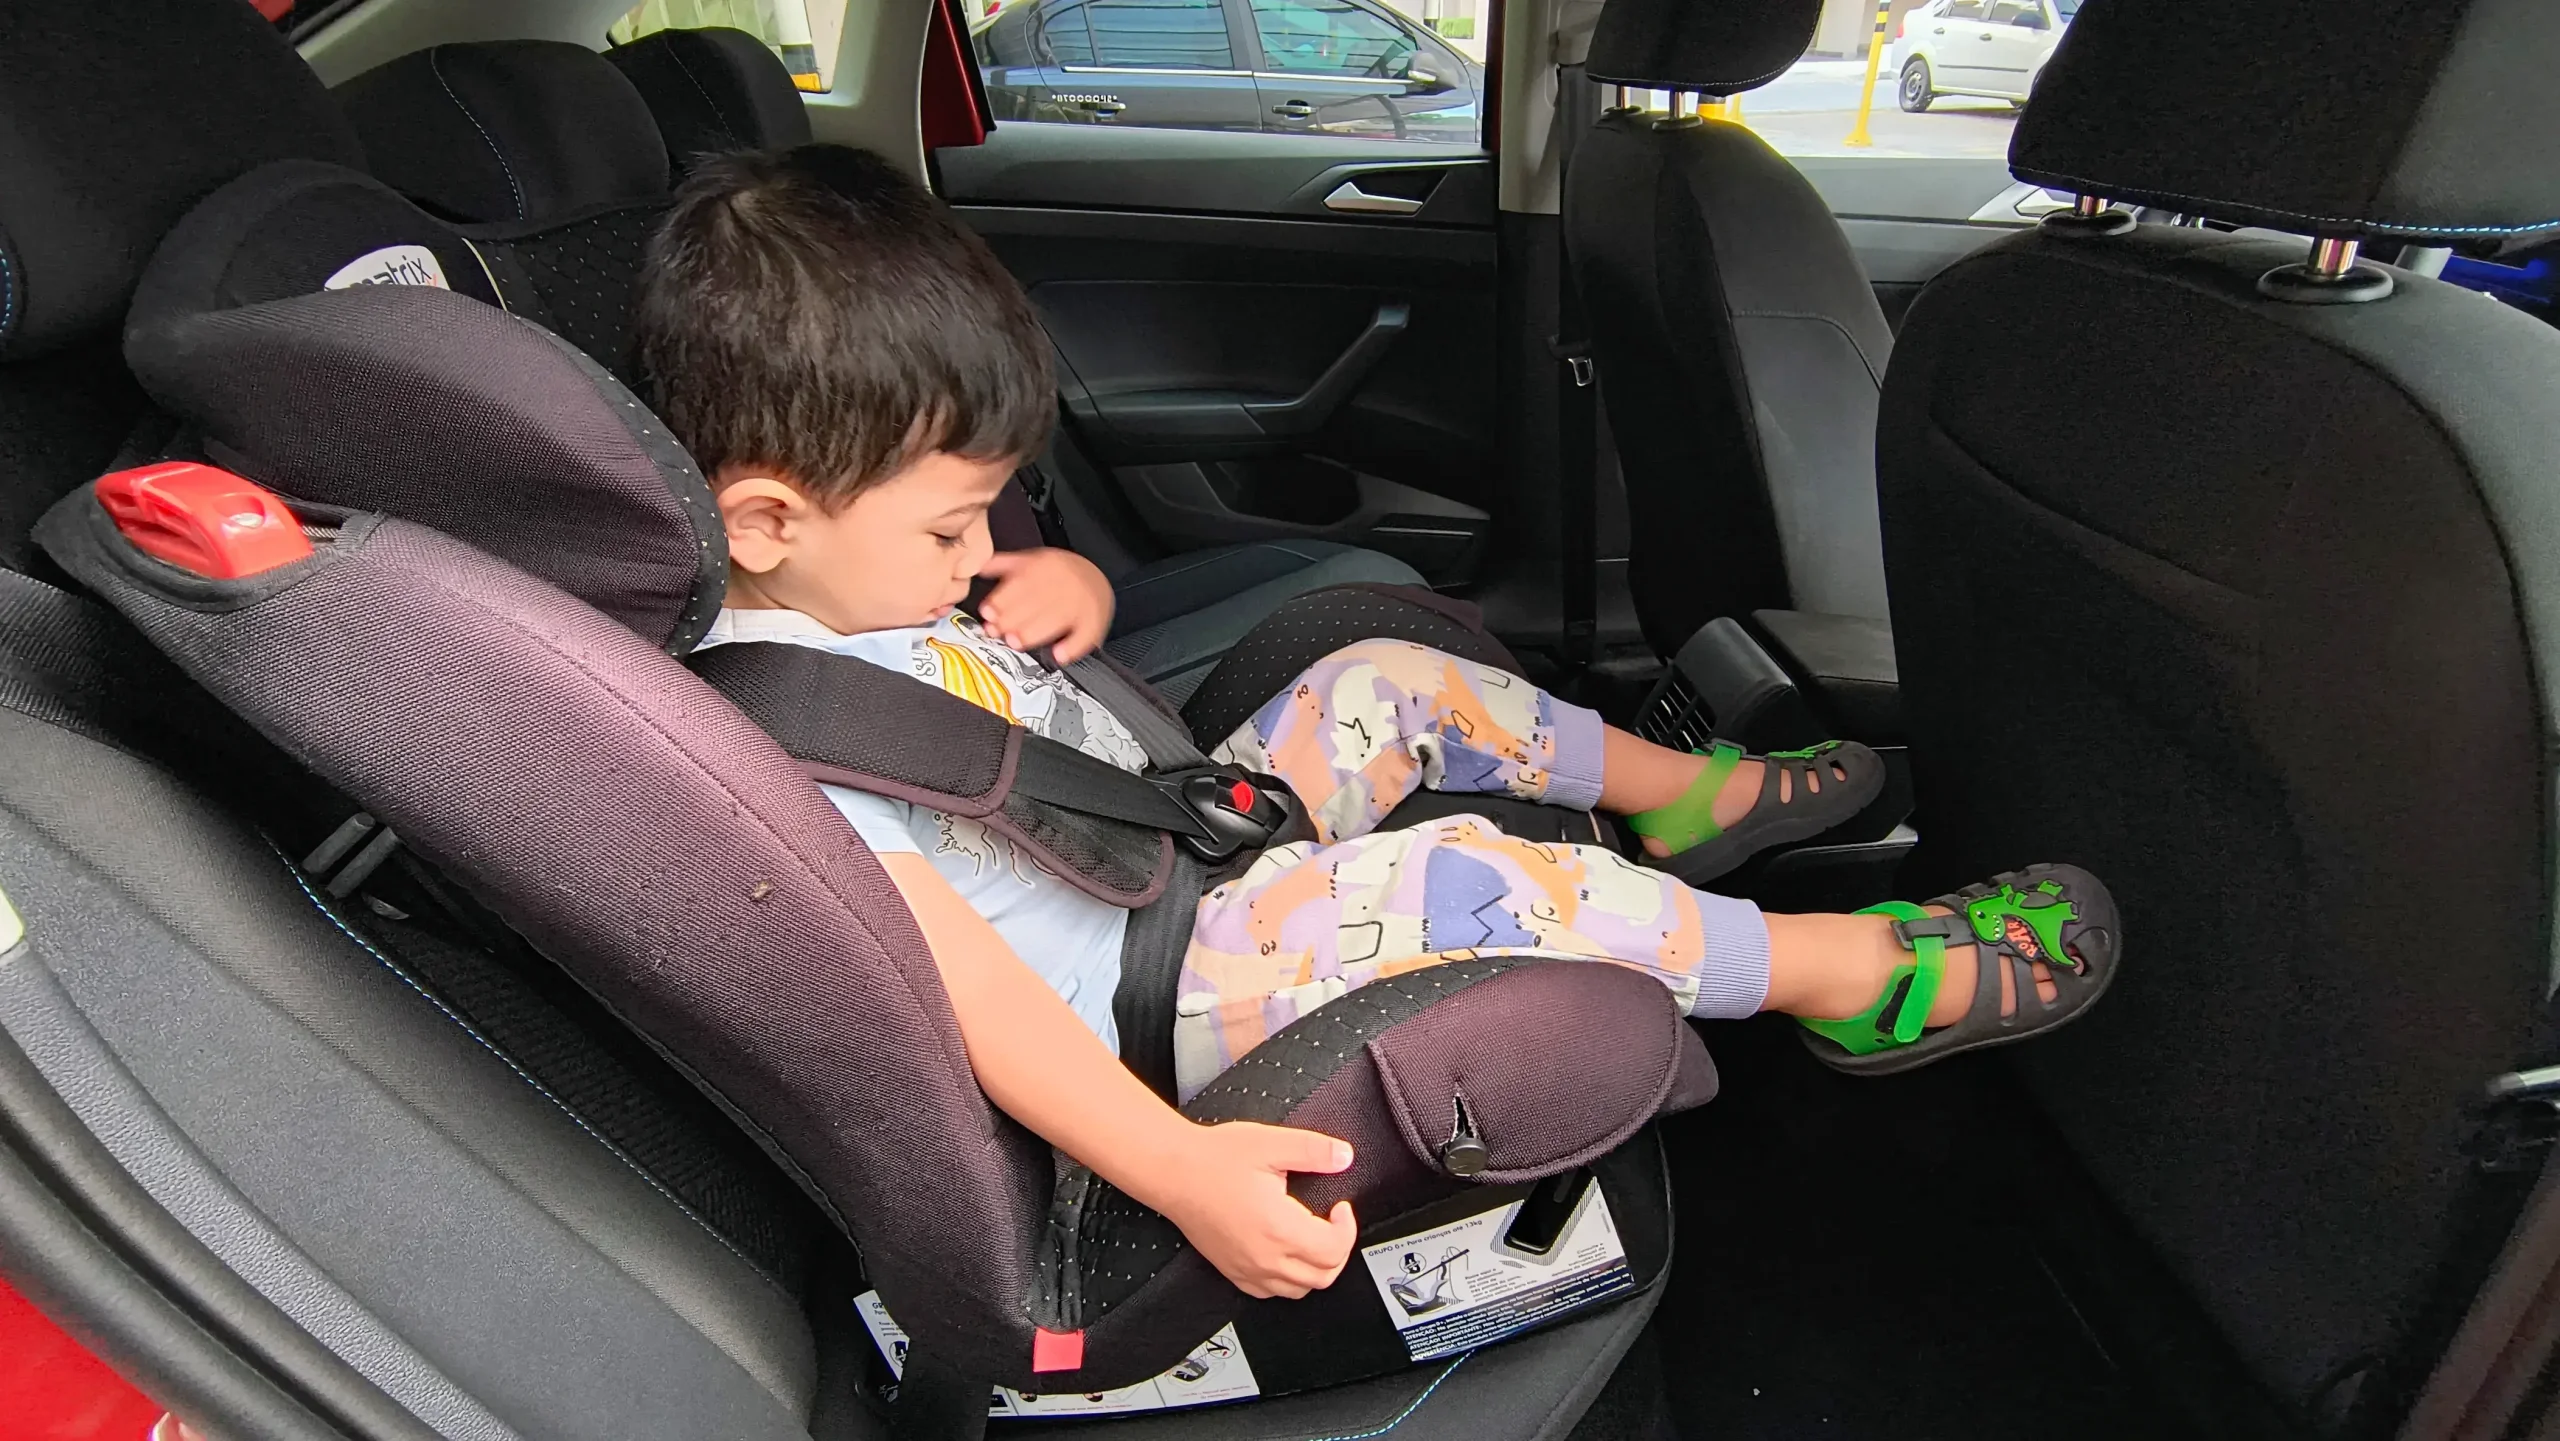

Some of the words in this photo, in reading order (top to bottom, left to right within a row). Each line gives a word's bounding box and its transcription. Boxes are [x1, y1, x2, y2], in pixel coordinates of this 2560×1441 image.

[349, 254, 432, 285] atrix
[2006, 921, 2039, 958] ROAR
[1367, 1245, 1393, 1256] GRUPO
[1406, 1237, 1422, 1245] Para
[1423, 1228, 1452, 1242] crianças
[1451, 1224, 1463, 1232] até
[1465, 1219, 1482, 1229] 13kg
